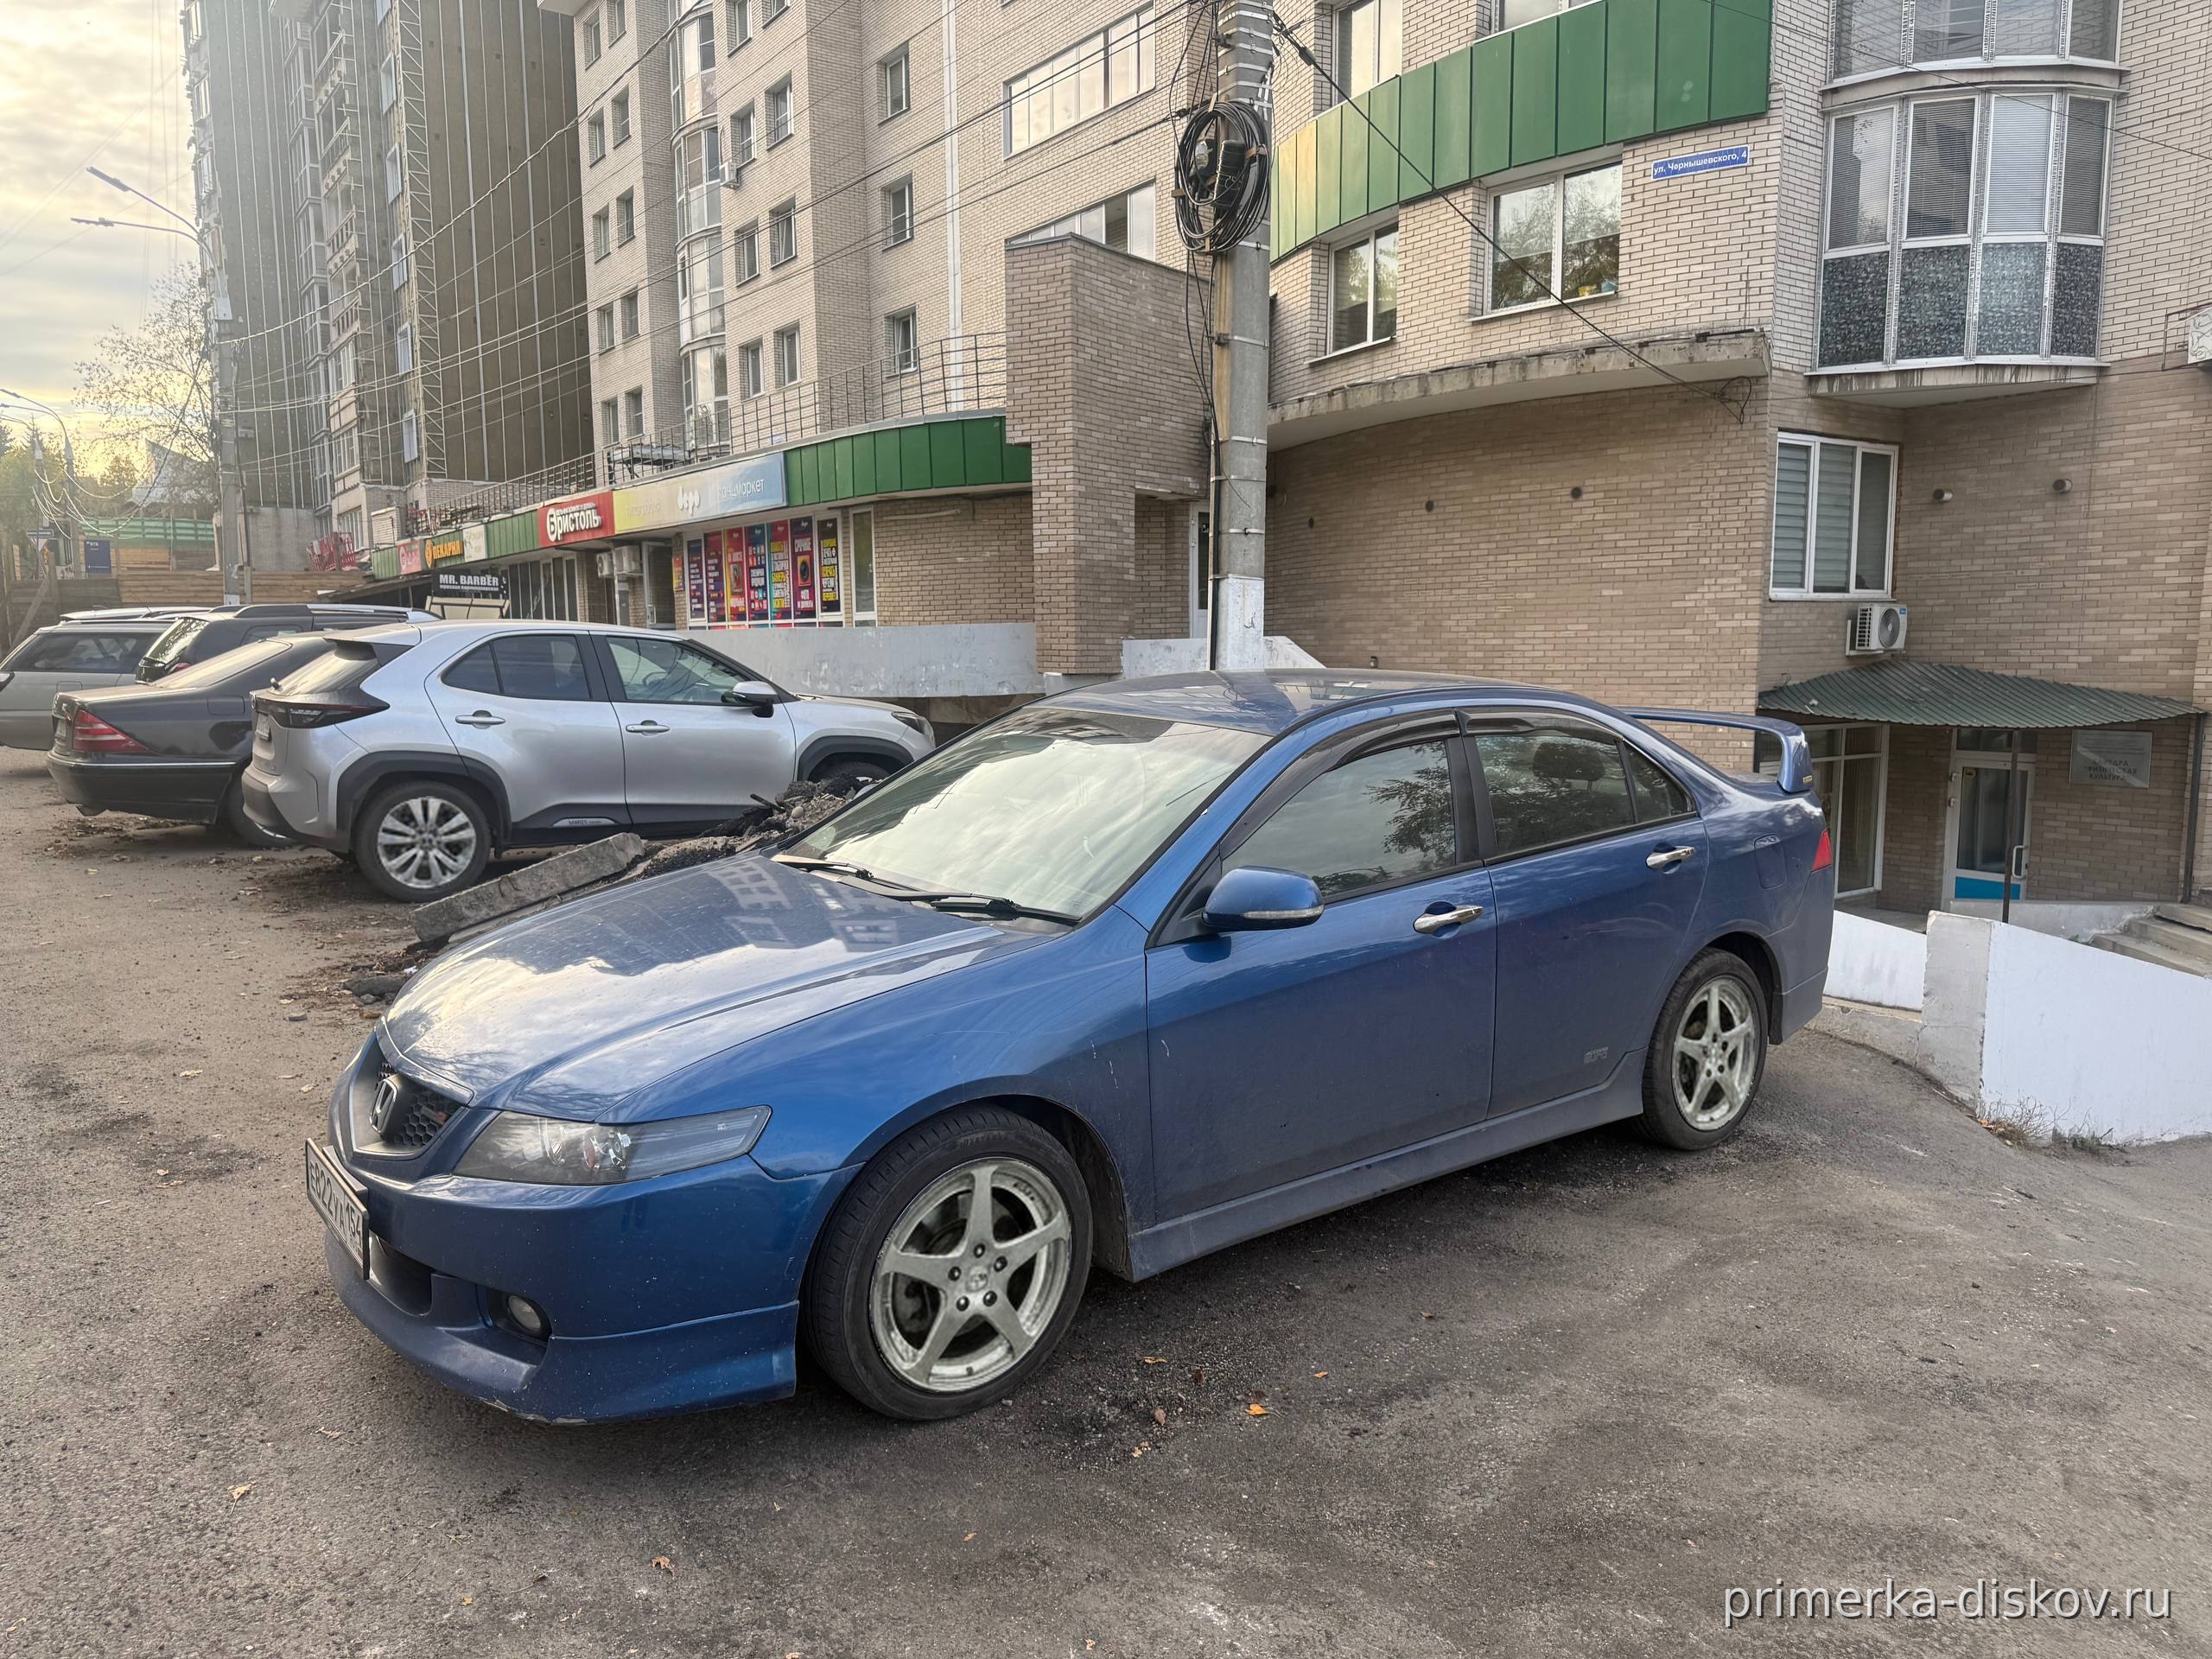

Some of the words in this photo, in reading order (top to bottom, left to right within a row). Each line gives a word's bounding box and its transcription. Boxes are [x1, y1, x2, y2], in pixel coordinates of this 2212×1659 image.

[1654, 167, 1666, 175] ул.
[1668, 153, 1739, 171] Чернышевского,
[547, 508, 601, 542] Бристоль
[439, 574, 459, 585] MR.
[460, 575, 499, 587] BARBER
